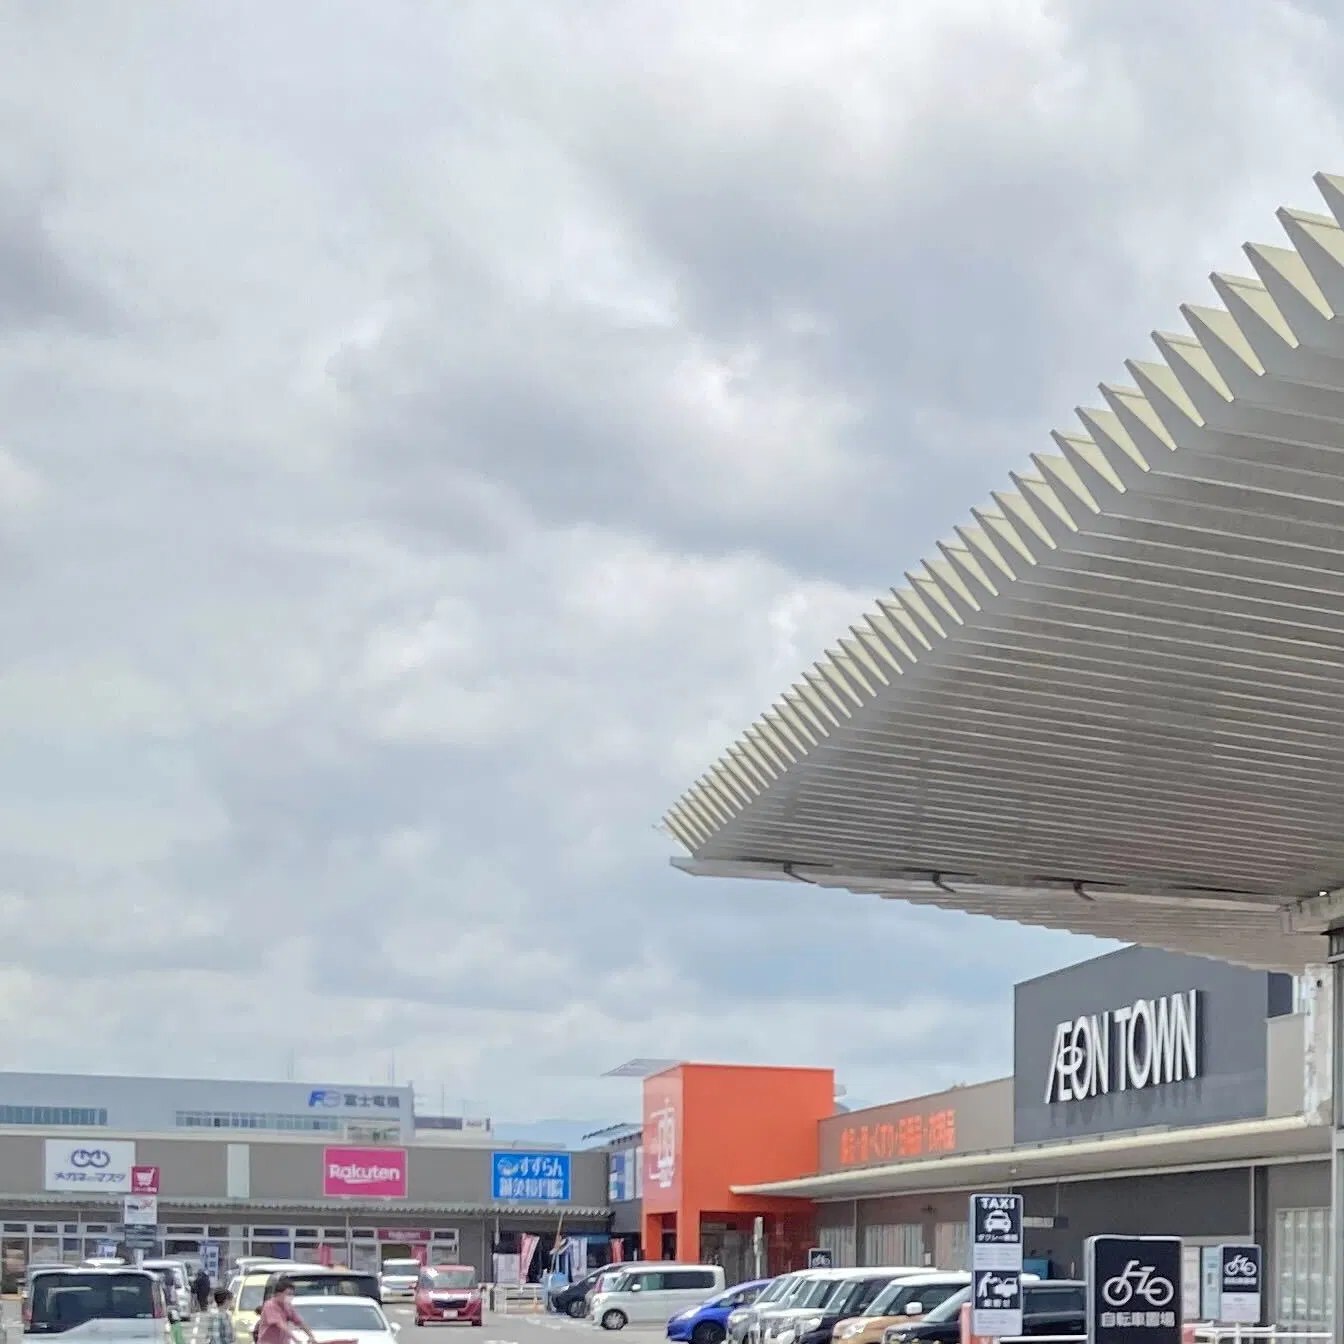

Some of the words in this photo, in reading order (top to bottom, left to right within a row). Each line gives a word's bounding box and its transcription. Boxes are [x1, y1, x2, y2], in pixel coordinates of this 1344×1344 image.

[1113, 988, 1197, 1091] TOWN
[328, 1162, 401, 1184] Rakuten
[979, 1197, 1016, 1210] TAXI
